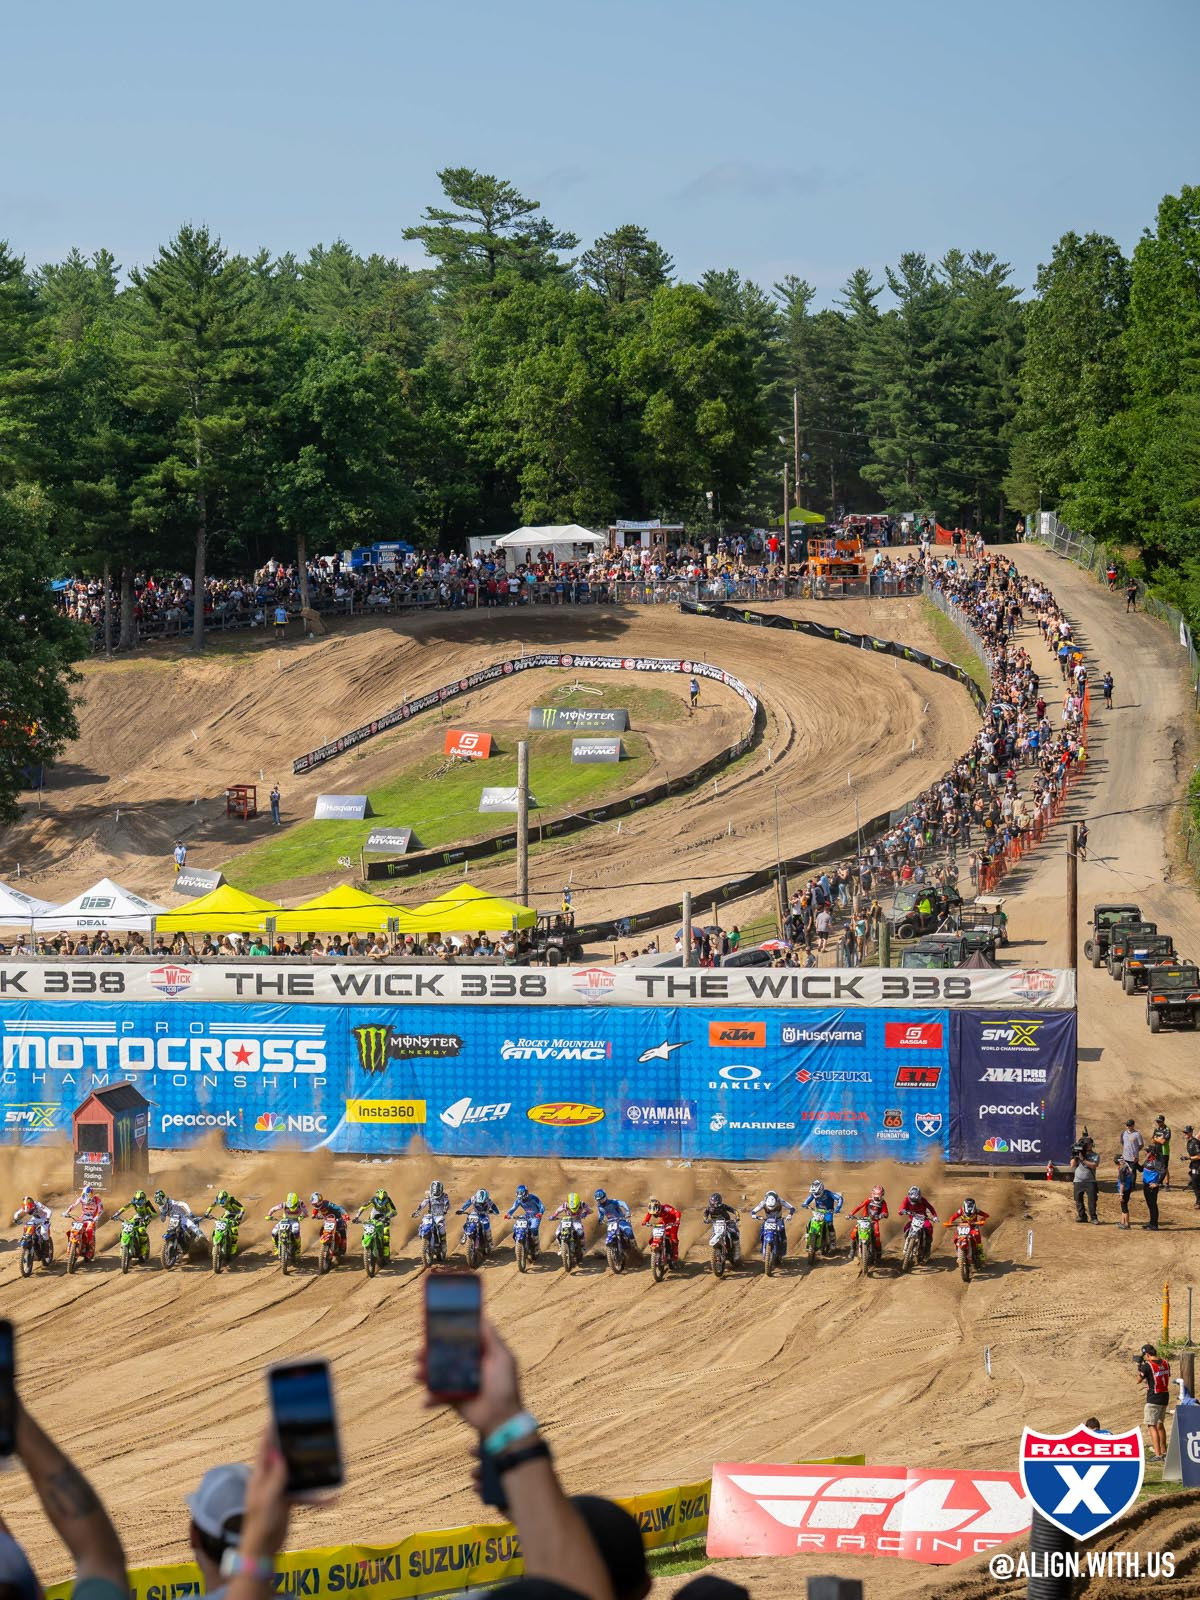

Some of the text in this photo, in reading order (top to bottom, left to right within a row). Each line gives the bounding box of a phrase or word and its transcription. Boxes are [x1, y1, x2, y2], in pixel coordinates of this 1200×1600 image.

[560, 710, 615, 720] MONSTER
[44, 970, 126, 993] 338
[166, 970, 191, 984] WICK
[588, 973, 615, 988] WICK
[1027, 975, 1054, 991] WICK
[225, 973, 547, 997] THE WICK 338
[635, 975, 972, 999] THE WICK 338
[121, 1021, 204, 1034] PRO
[719, 1027, 755, 1041] KTM
[390, 1034, 459, 1049] MONSTER
[796, 1029, 862, 1043] Husqvarna
[980, 1025, 1040, 1046] SMX
[517, 1038, 605, 1048] ROCKY MOUNTAIN
[3, 1036, 327, 1074] MOTOCROSS
[3, 1072, 327, 1089] CHAMPIONSHIP
[812, 1071, 872, 1082] SUZUKI
[898, 1066, 941, 1083] ETS
[978, 1067, 1047, 1083] AMA PRO
[708, 1082, 772, 1090] OAKLEY
[4, 1107, 57, 1127] SMX
[358, 1105, 414, 1118] Insta360
[459, 1103, 511, 1120] UFO
[527, 1105, 605, 1121] FMF
[642, 1106, 691, 1120] YAMAHA
[801, 1111, 870, 1121] HONDA
[979, 1102, 1040, 1119] peacock
[162, 1110, 237, 1133] peacock
[287, 1115, 327, 1134] NBC
[463, 1112, 508, 1125] PLAST
[729, 1121, 796, 1130] MARINES
[886, 1118, 901, 1127] 66
[814, 1127, 858, 1136] Generators
[923, 1121, 935, 1133] X
[876, 1131, 910, 1139] FOUNDATION
[1010, 1138, 1041, 1152] NBC
[76, 1151, 111, 1164] AMA
[83, 1172, 102, 1180] Riding.
[83, 1180, 103, 1188] Racing.
[727, 1475, 1033, 1534] FLY
[797, 1535, 1003, 1552] RACING
[327, 1553, 401, 1593] SUZUKI
[408, 1541, 481, 1578] SUZUKI
